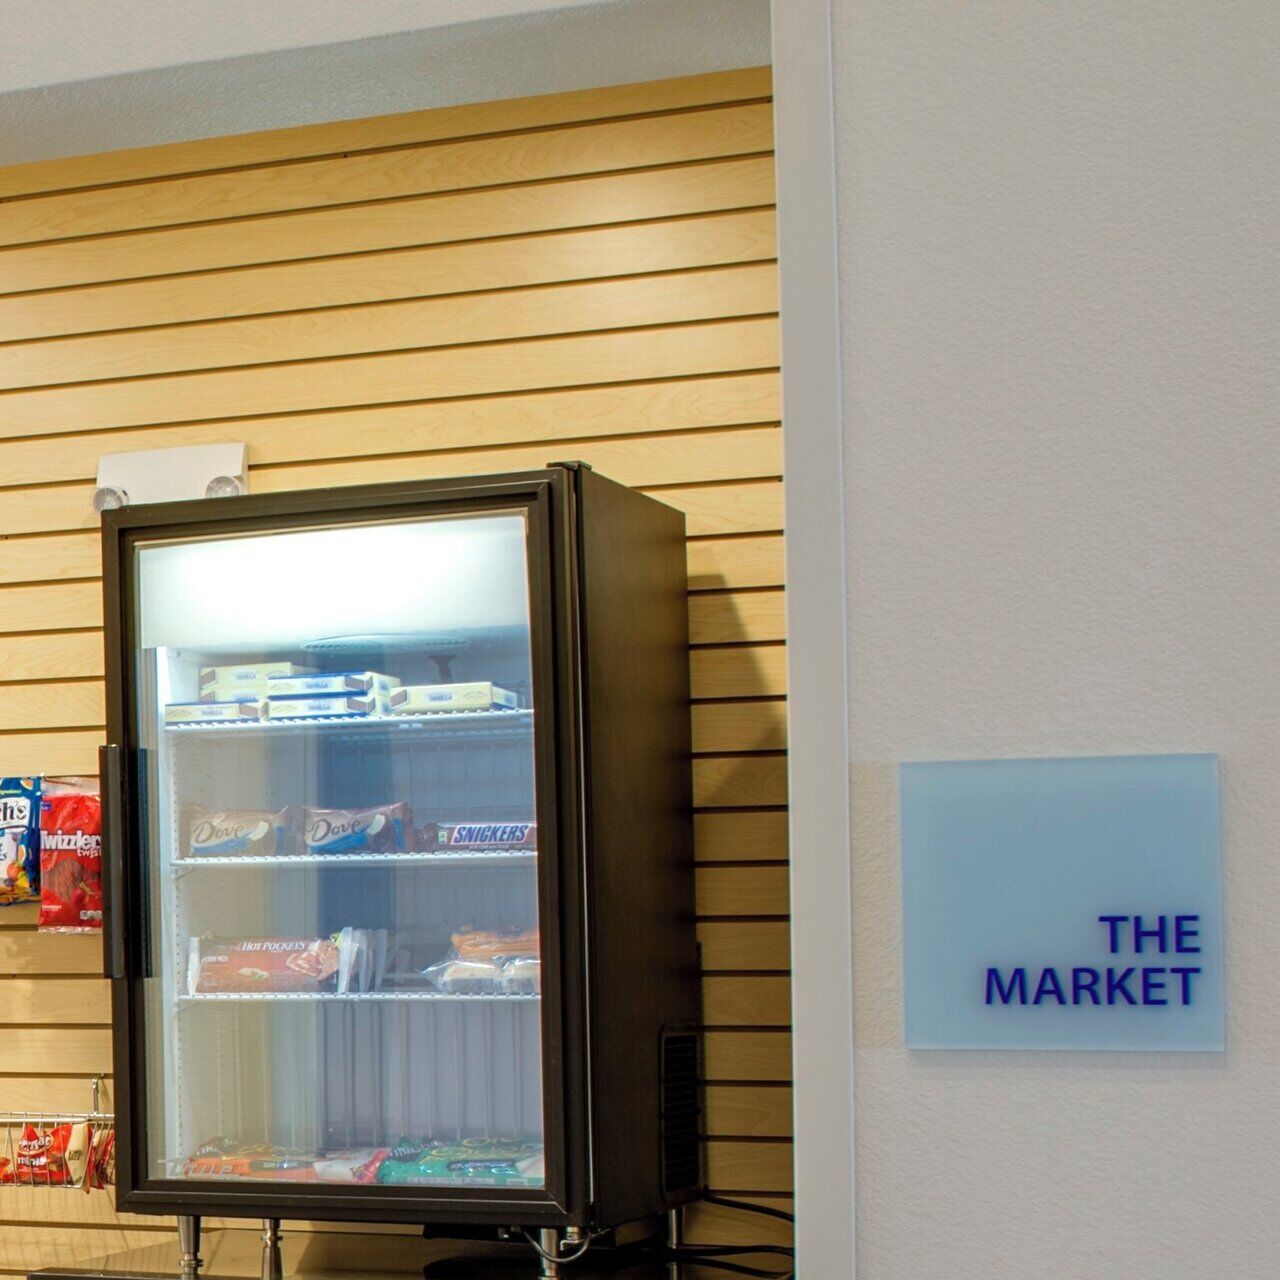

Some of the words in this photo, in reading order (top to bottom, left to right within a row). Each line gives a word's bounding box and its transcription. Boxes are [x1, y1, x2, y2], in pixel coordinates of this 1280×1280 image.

[192, 821, 245, 844] Dove
[306, 818, 361, 843] Dove
[453, 825, 529, 843] SNICKERS
[241, 942, 260, 951] HOT
[262, 941, 305, 951] POCKETS
[1098, 915, 1201, 954] THE
[984, 967, 1202, 1006] MARKET
